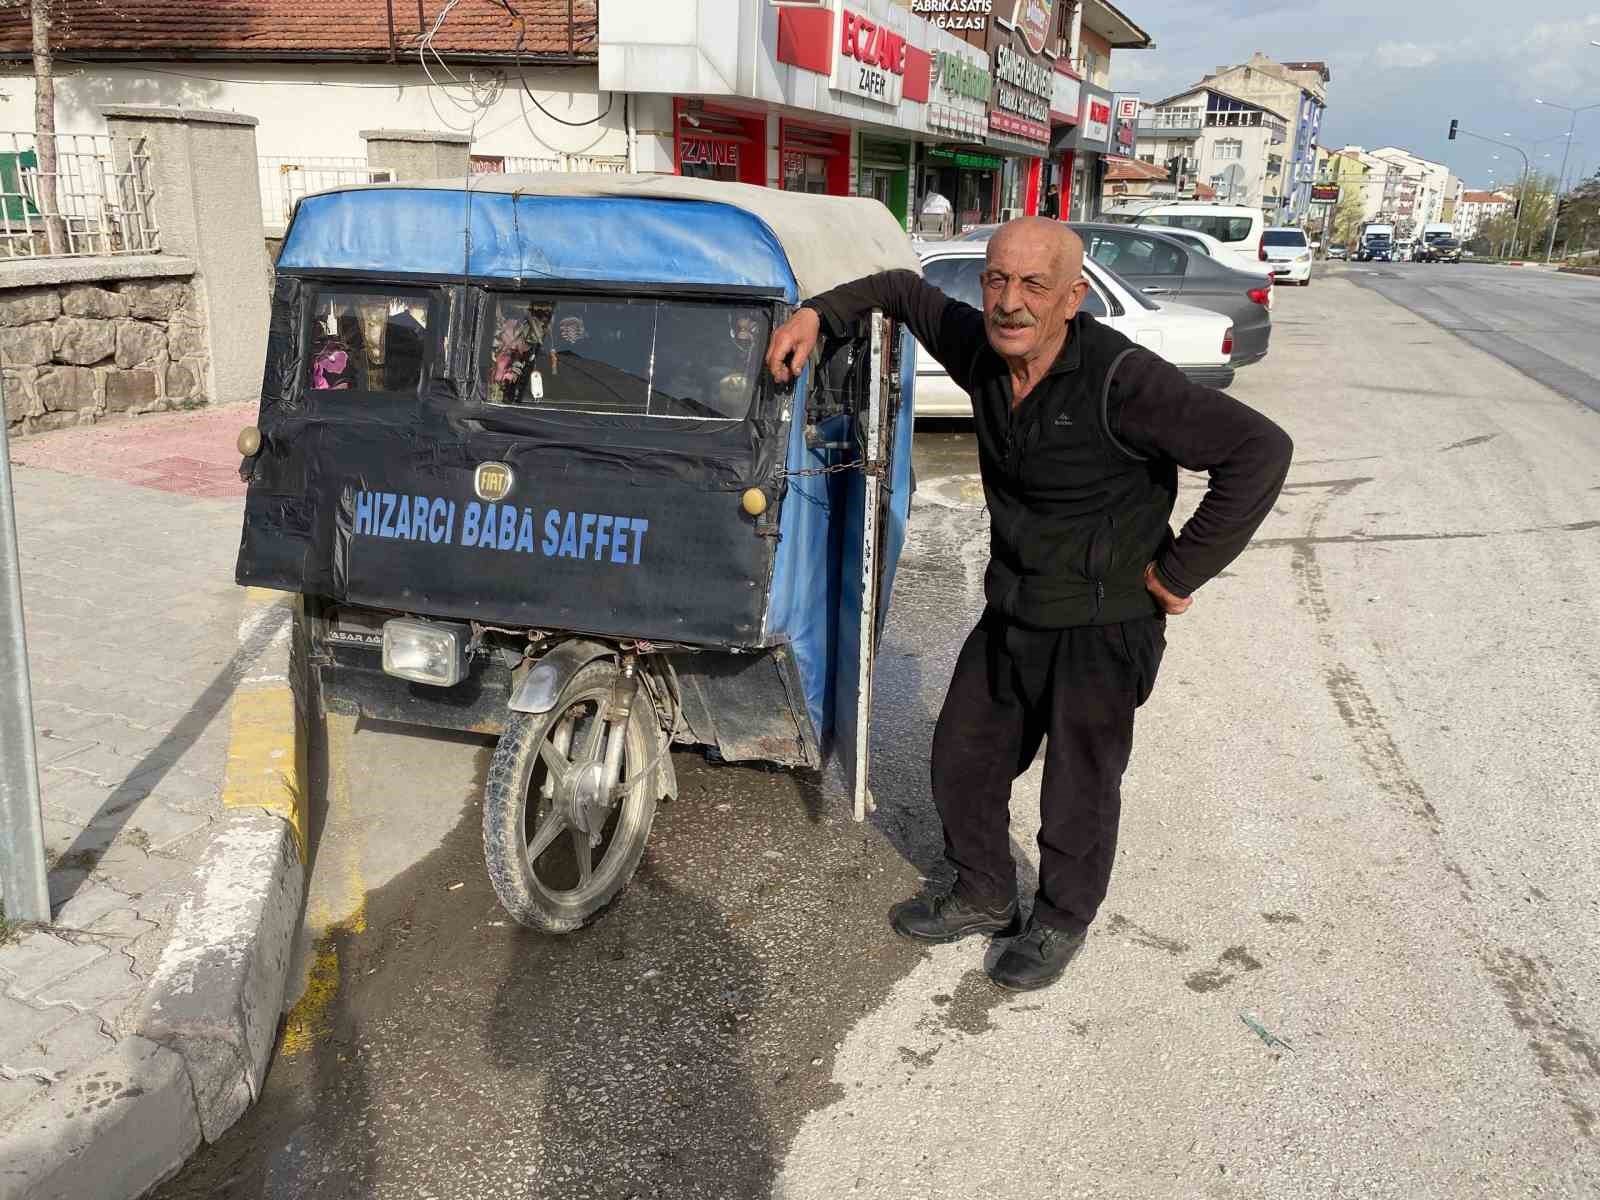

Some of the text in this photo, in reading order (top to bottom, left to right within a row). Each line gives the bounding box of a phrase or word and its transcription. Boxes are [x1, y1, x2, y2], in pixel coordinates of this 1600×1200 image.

[959, 0, 993, 15] SATIŞ
[921, 13, 985, 30] AĞAZASI
[842, 9, 907, 76] ECZANE
[858, 68, 887, 97] ZAFER
[1123, 103, 1133, 114] E
[480, 471, 505, 491] FIAT
[355, 491, 456, 545] HIZARCI
[541, 508, 649, 565] SAFFET
